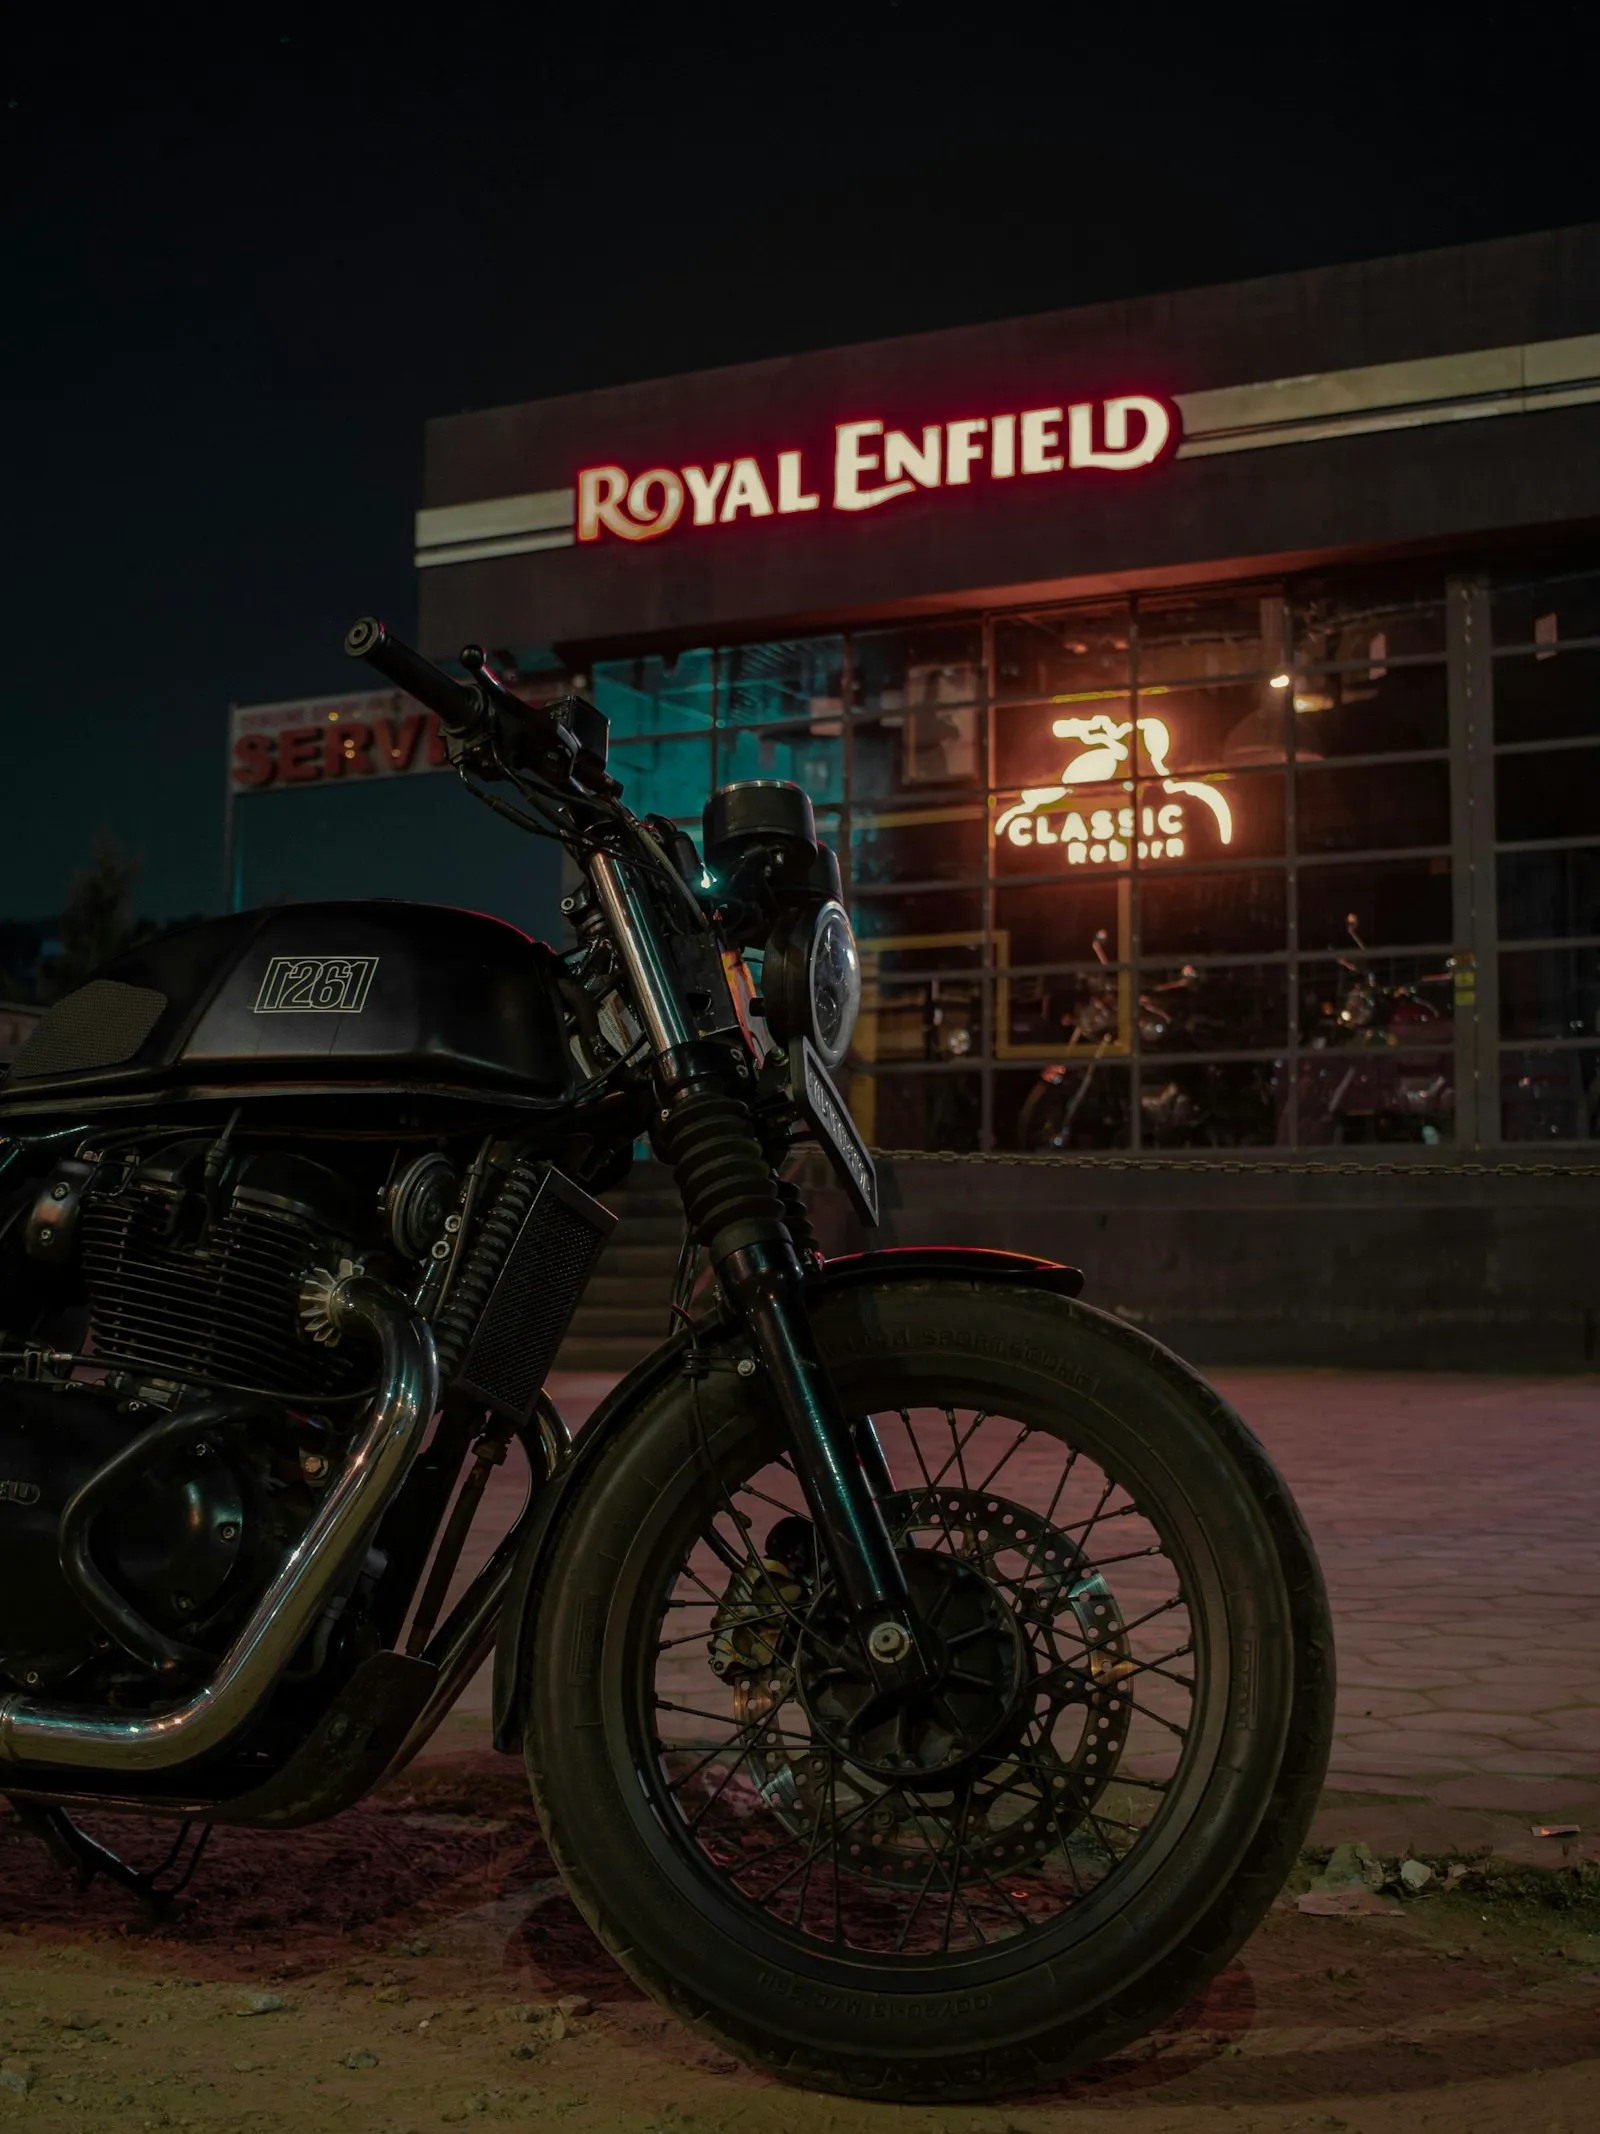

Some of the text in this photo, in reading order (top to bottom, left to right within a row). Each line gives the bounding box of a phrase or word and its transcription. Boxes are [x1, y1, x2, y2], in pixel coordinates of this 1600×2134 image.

[577, 394, 1171, 542] ROYAL ENFIELD
[1008, 803, 1184, 847] CLASSIC
[263, 959, 370, 1009] 1261
